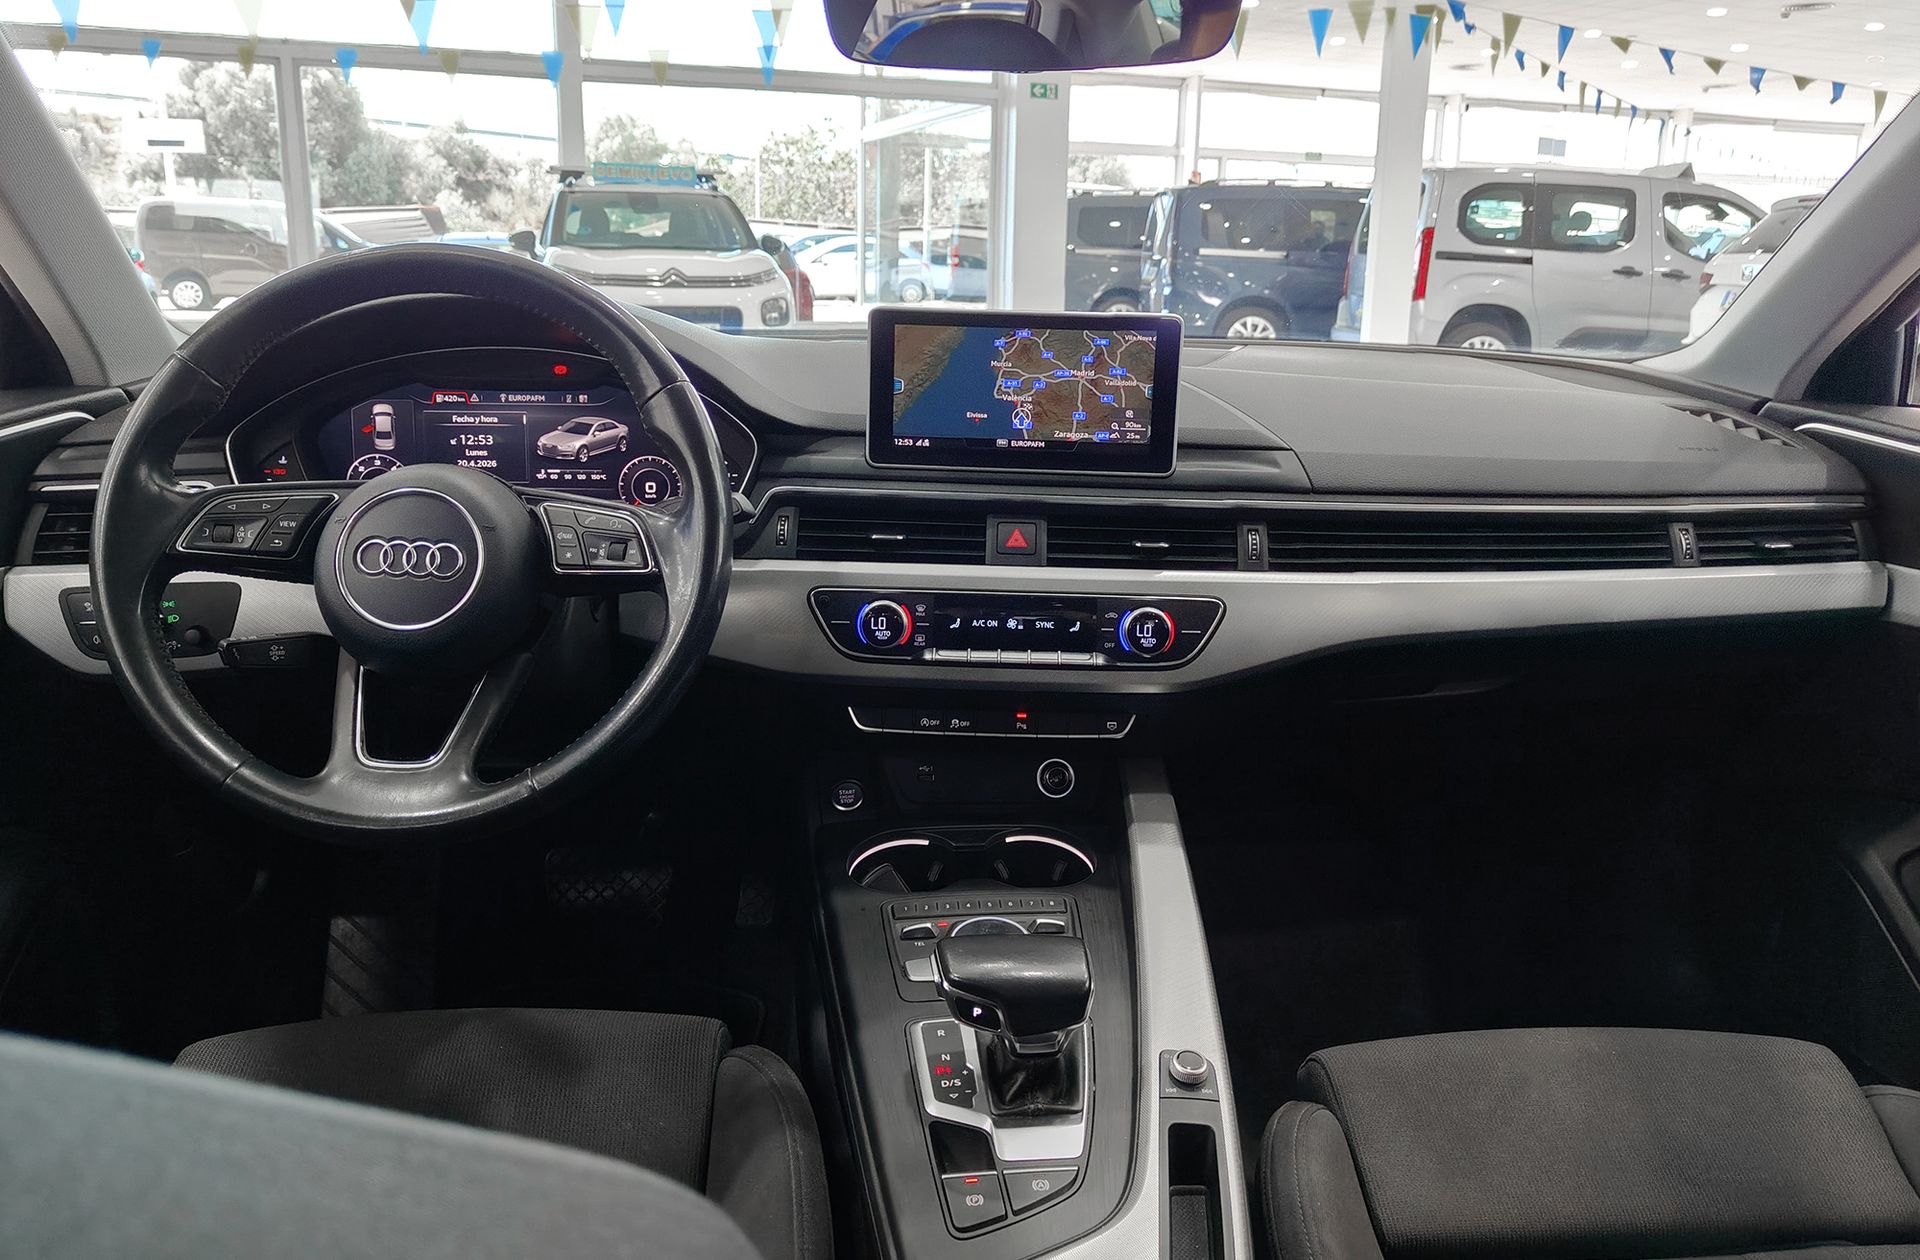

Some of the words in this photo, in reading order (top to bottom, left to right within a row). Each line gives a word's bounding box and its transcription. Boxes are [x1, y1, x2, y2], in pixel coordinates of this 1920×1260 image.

[596, 165, 693, 180] SEMINUEVO
[1104, 379, 1137, 387] Valladolid
[508, 394, 546, 402] EUROPAFM
[452, 415, 474, 423] Fecha
[474, 416, 480, 424] y
[481, 415, 498, 423] hora
[966, 411, 988, 419] Eivissa
[459, 434, 494, 445] 12:53
[1053, 430, 1089, 440] Zaragoza
[893, 438, 913, 446] 12:53
[1010, 440, 1045, 448] EUROPAFM
[465, 448, 488, 457] Lunes
[457, 459, 498, 468] 20.4.2026
[278, 520, 297, 528] VIEW
[871, 616, 887, 630] LO
[972, 618, 985, 627] A/C
[987, 619, 998, 628] ON
[1035, 621, 1055, 629] SYNC
[1136, 624, 1152, 637] LO
[973, 1007, 982, 1017] P
[937, 1029, 946, 1037] R
[941, 1053, 951, 1061] N
[940, 1078, 962, 1088] D/S
